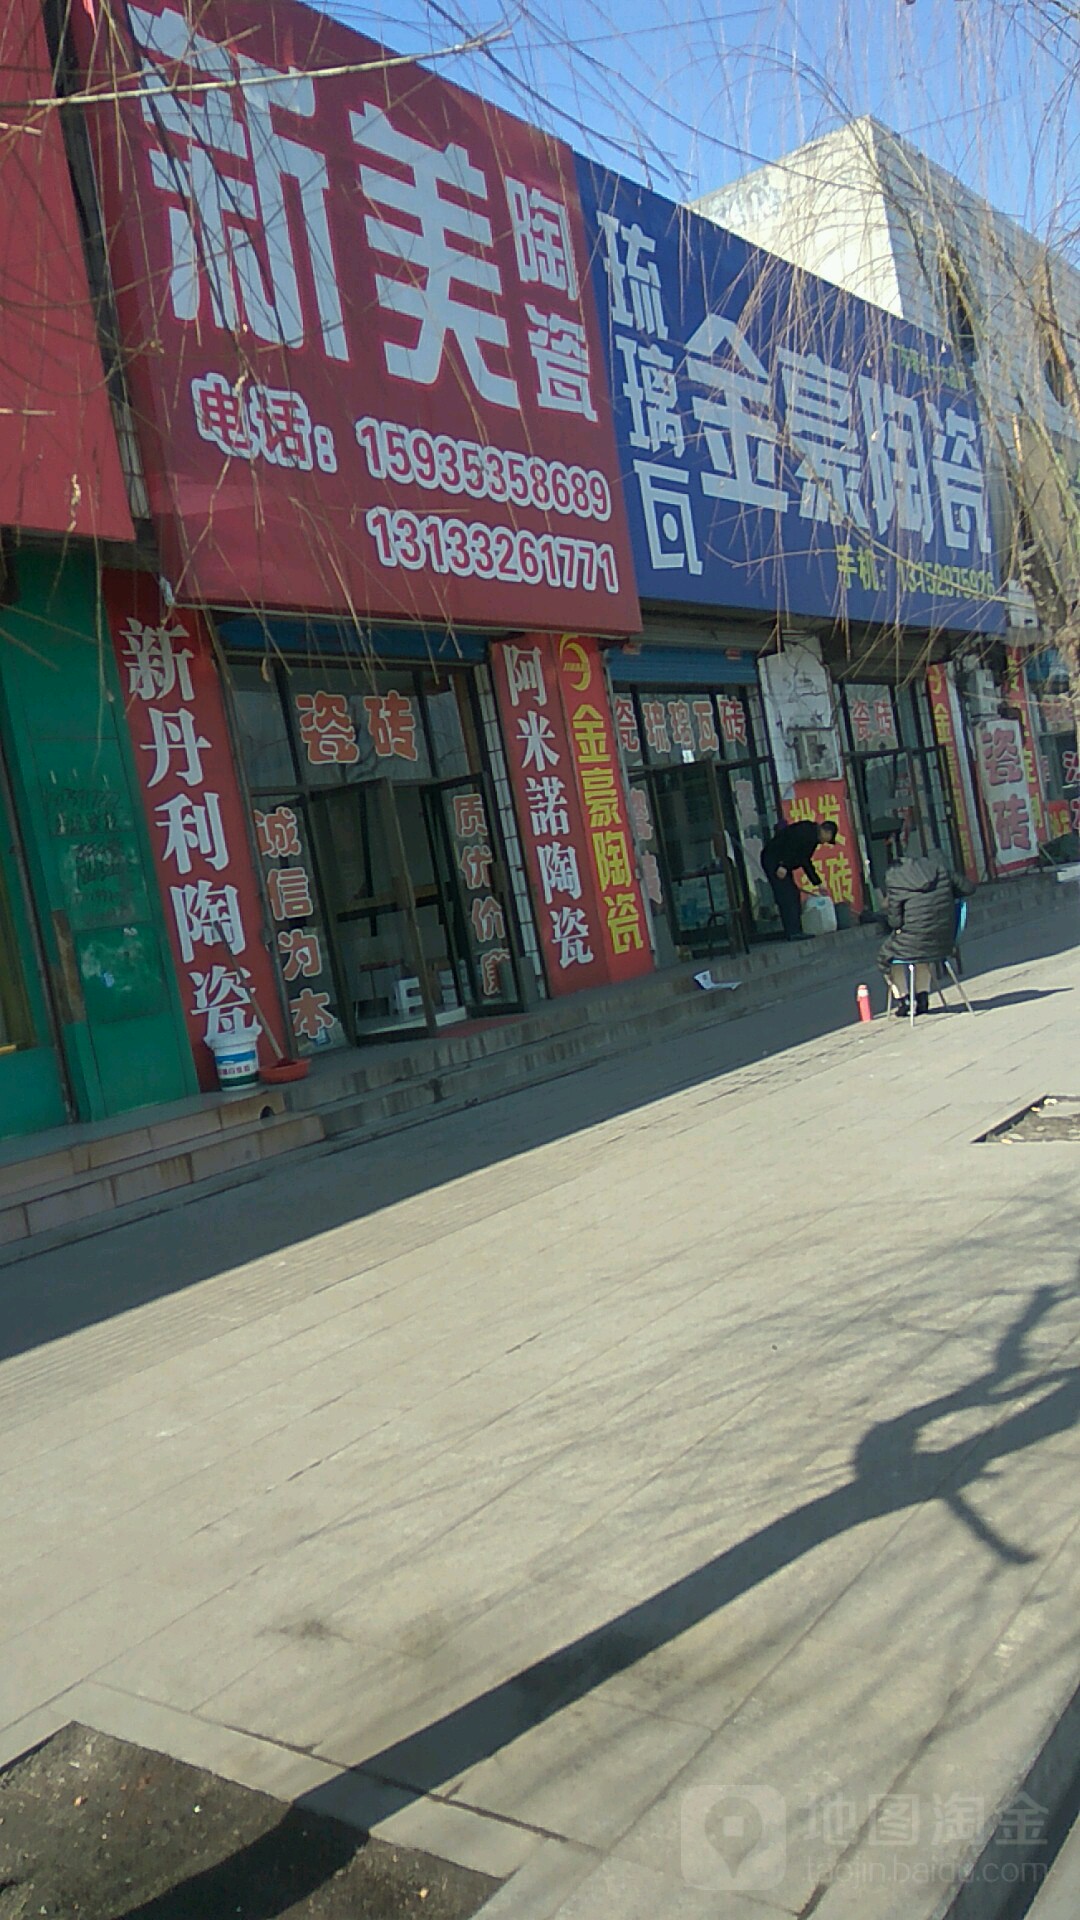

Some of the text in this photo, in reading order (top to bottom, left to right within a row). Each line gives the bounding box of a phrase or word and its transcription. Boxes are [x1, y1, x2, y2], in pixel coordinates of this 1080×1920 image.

[130, 4, 520, 410] 新美
[505, 176, 598, 422] 陶瓷
[355, 417, 611, 521] 15935358689
[597, 210, 702, 575] 琉璃瓦
[684, 314, 992, 554] 金豪陶瓷
[366, 507, 619, 594] 13133261771
[119, 617, 262, 1037] 新丹利陶瓷
[297, 690, 418, 764] 瓷砖
[571, 703, 643, 954] 金豪陶瓷
[852, 698, 893, 742] 瓷砖
[982, 727, 1032, 851] 瓷砖
[253, 806, 337, 1040] 诚信为本
